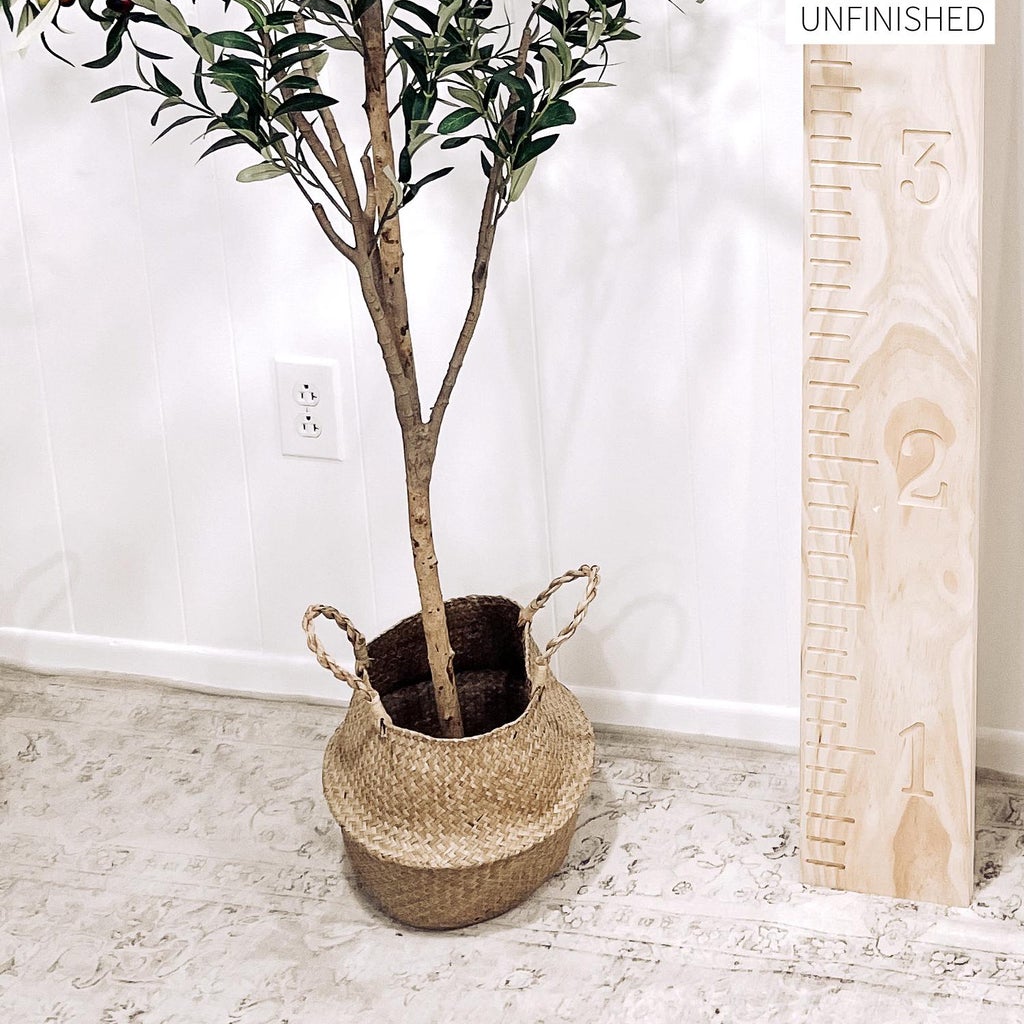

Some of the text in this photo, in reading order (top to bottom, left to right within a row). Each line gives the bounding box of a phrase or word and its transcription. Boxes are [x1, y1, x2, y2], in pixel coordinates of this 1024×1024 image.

[900, 129, 952, 207] 3
[896, 427, 950, 509] 2
[898, 721, 933, 797] 1
